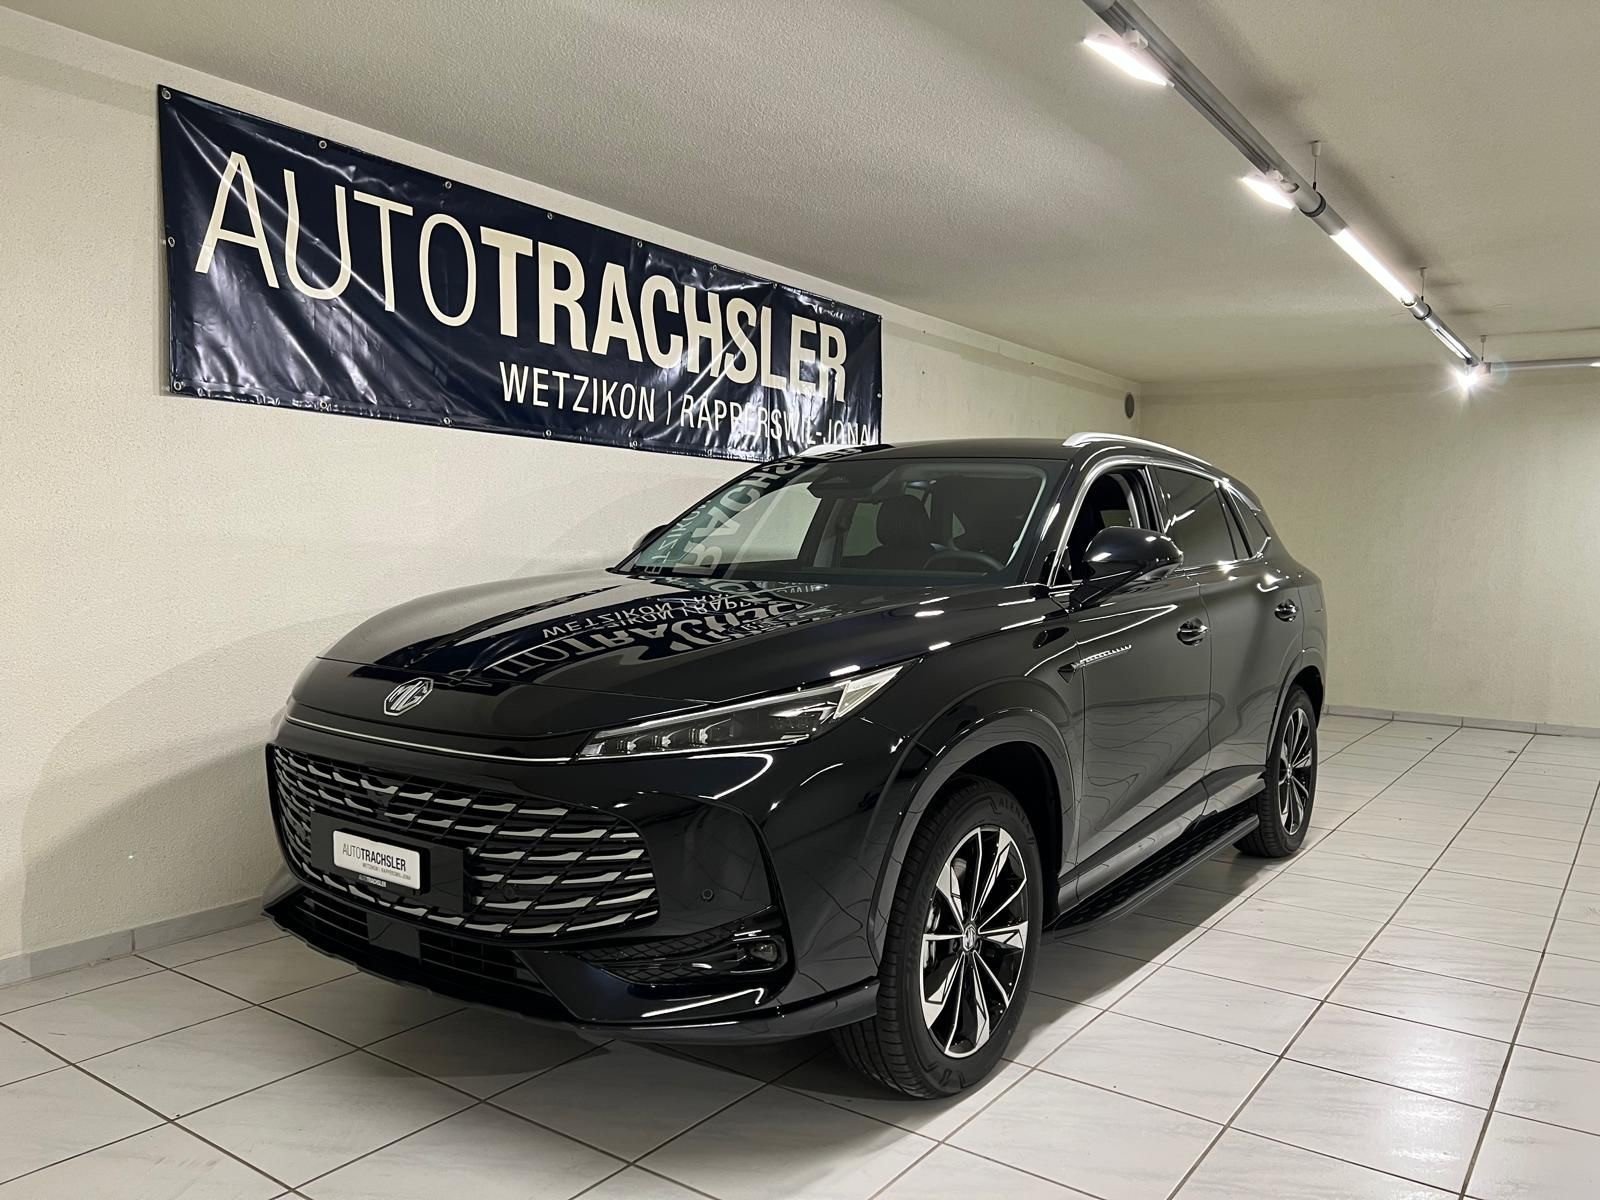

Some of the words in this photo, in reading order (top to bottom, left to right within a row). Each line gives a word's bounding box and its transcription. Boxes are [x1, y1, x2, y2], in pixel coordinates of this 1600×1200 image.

[194, 151, 848, 404] AUTOTRACHSLER
[499, 360, 656, 422] WETZIKON
[342, 843, 407, 872] AUTOTRACHSLER
